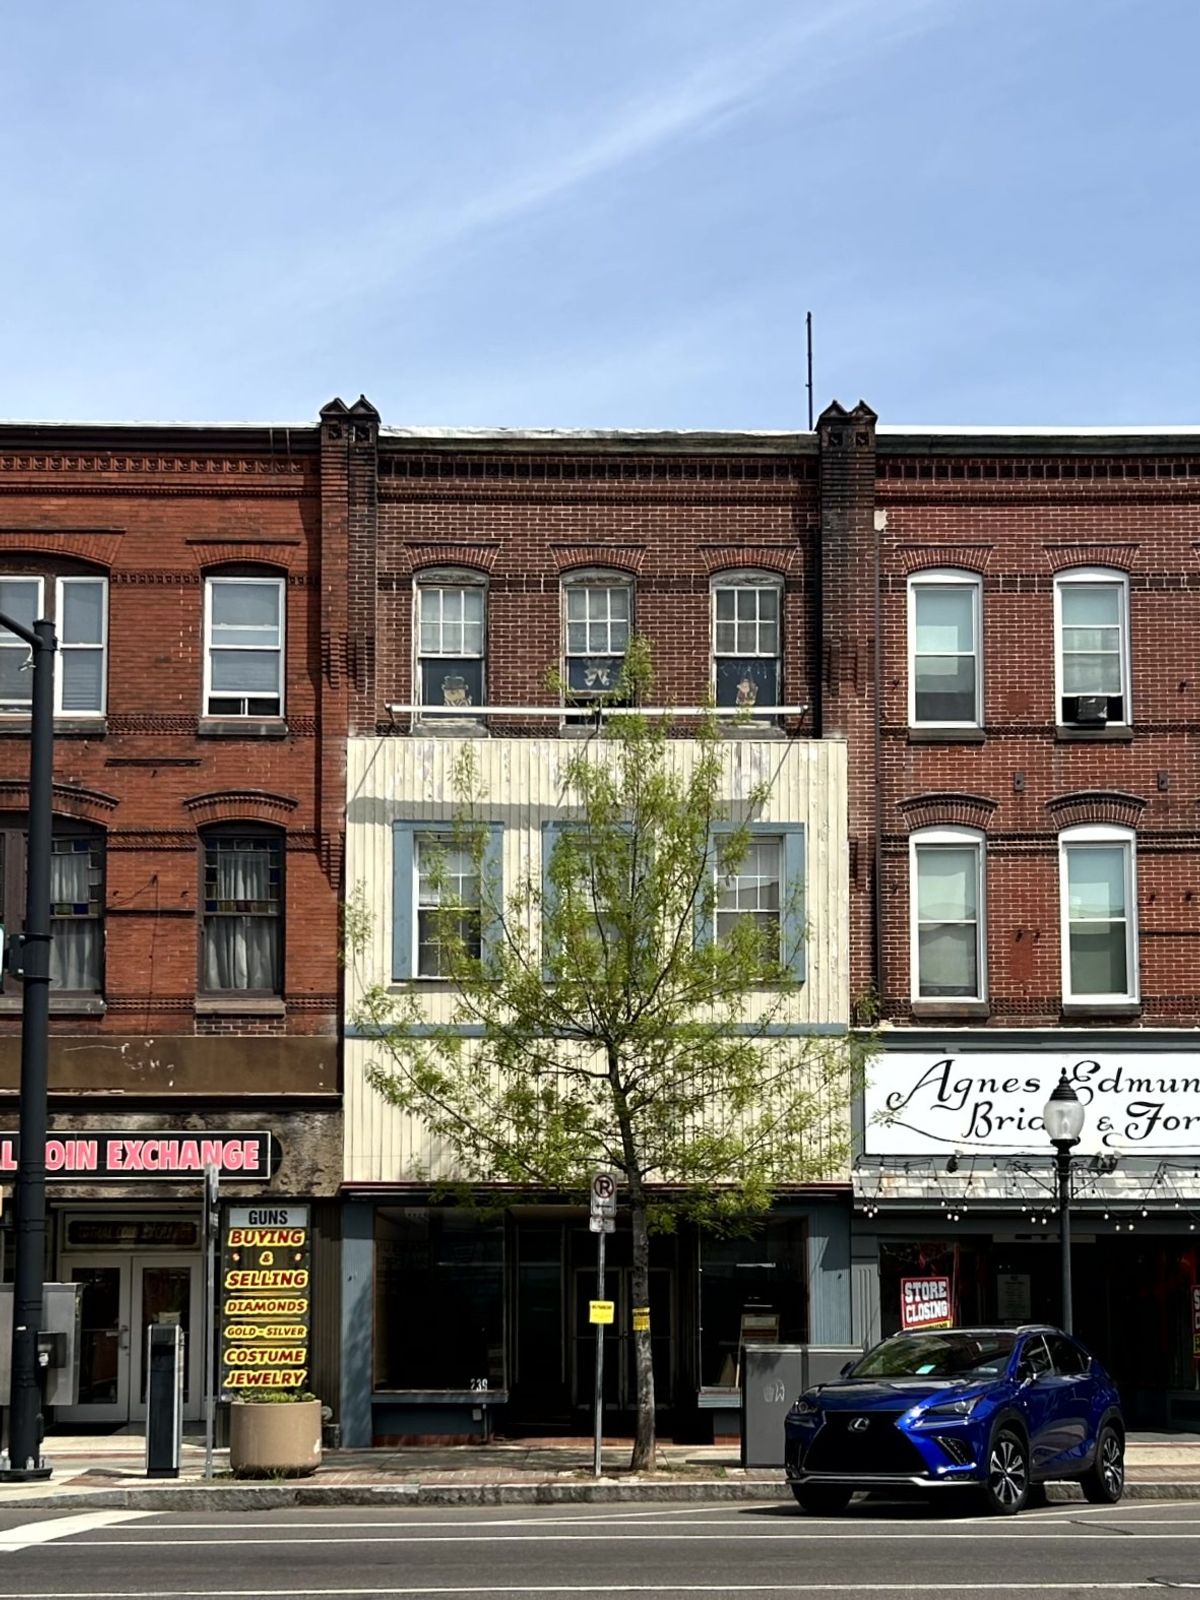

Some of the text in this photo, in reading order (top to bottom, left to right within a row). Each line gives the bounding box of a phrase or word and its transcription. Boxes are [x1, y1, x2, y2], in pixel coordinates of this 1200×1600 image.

[886, 1059, 1041, 1111] Agnes
[1097, 1116, 1114, 1132] &
[1124, 1101, 1200, 1140] For
[45, 1140, 98, 1171] OIN
[106, 1140, 260, 1171] EXCHANGE
[248, 1210, 288, 1225] GUNS
[229, 1229, 305, 1247] BUYING
[259, 1251, 274, 1265] &
[225, 1270, 308, 1289] SELLING
[904, 1281, 947, 1304] STORE
[225, 1299, 308, 1315] DIAMONDS
[905, 1300, 948, 1323] CLOSING
[225, 1326, 257, 1338] GOLD
[264, 1325, 307, 1338] SILVER
[224, 1348, 306, 1365] COSTUME
[224, 1369, 307, 1387] JEWELRY
